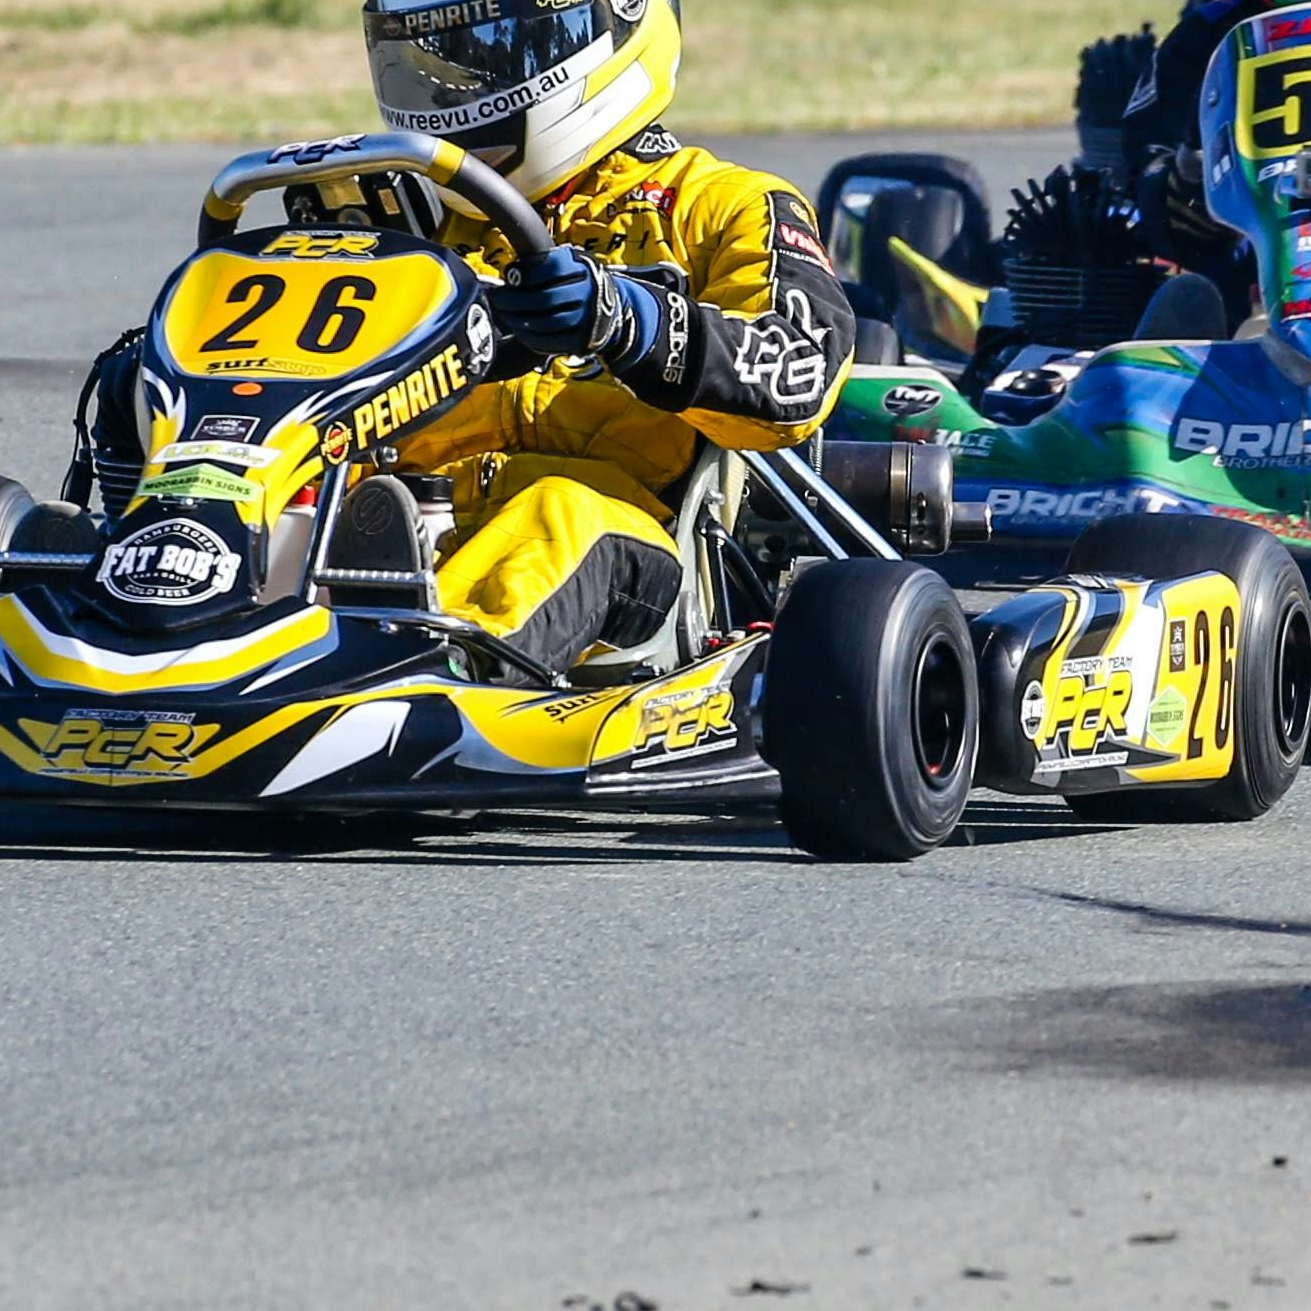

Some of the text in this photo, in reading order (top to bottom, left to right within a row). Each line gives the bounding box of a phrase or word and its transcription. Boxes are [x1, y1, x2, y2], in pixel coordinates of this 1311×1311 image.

[260, 235, 377, 258] PCR
[200, 274, 377, 353] 26
[663, 292, 689, 384] sparco
[353, 344, 467, 450] PENRITE
[216, 480, 251, 495] SIGNS
[96, 544, 242, 592] FAT BOB'S
[157, 589, 190, 597] BEER
[1062, 657, 1133, 674] FACTORY TEAM
[1186, 606, 1234, 760] 26
[633, 692, 736, 752] PCR
[1045, 670, 1132, 754] PCR
[44, 719, 194, 767] PCR
